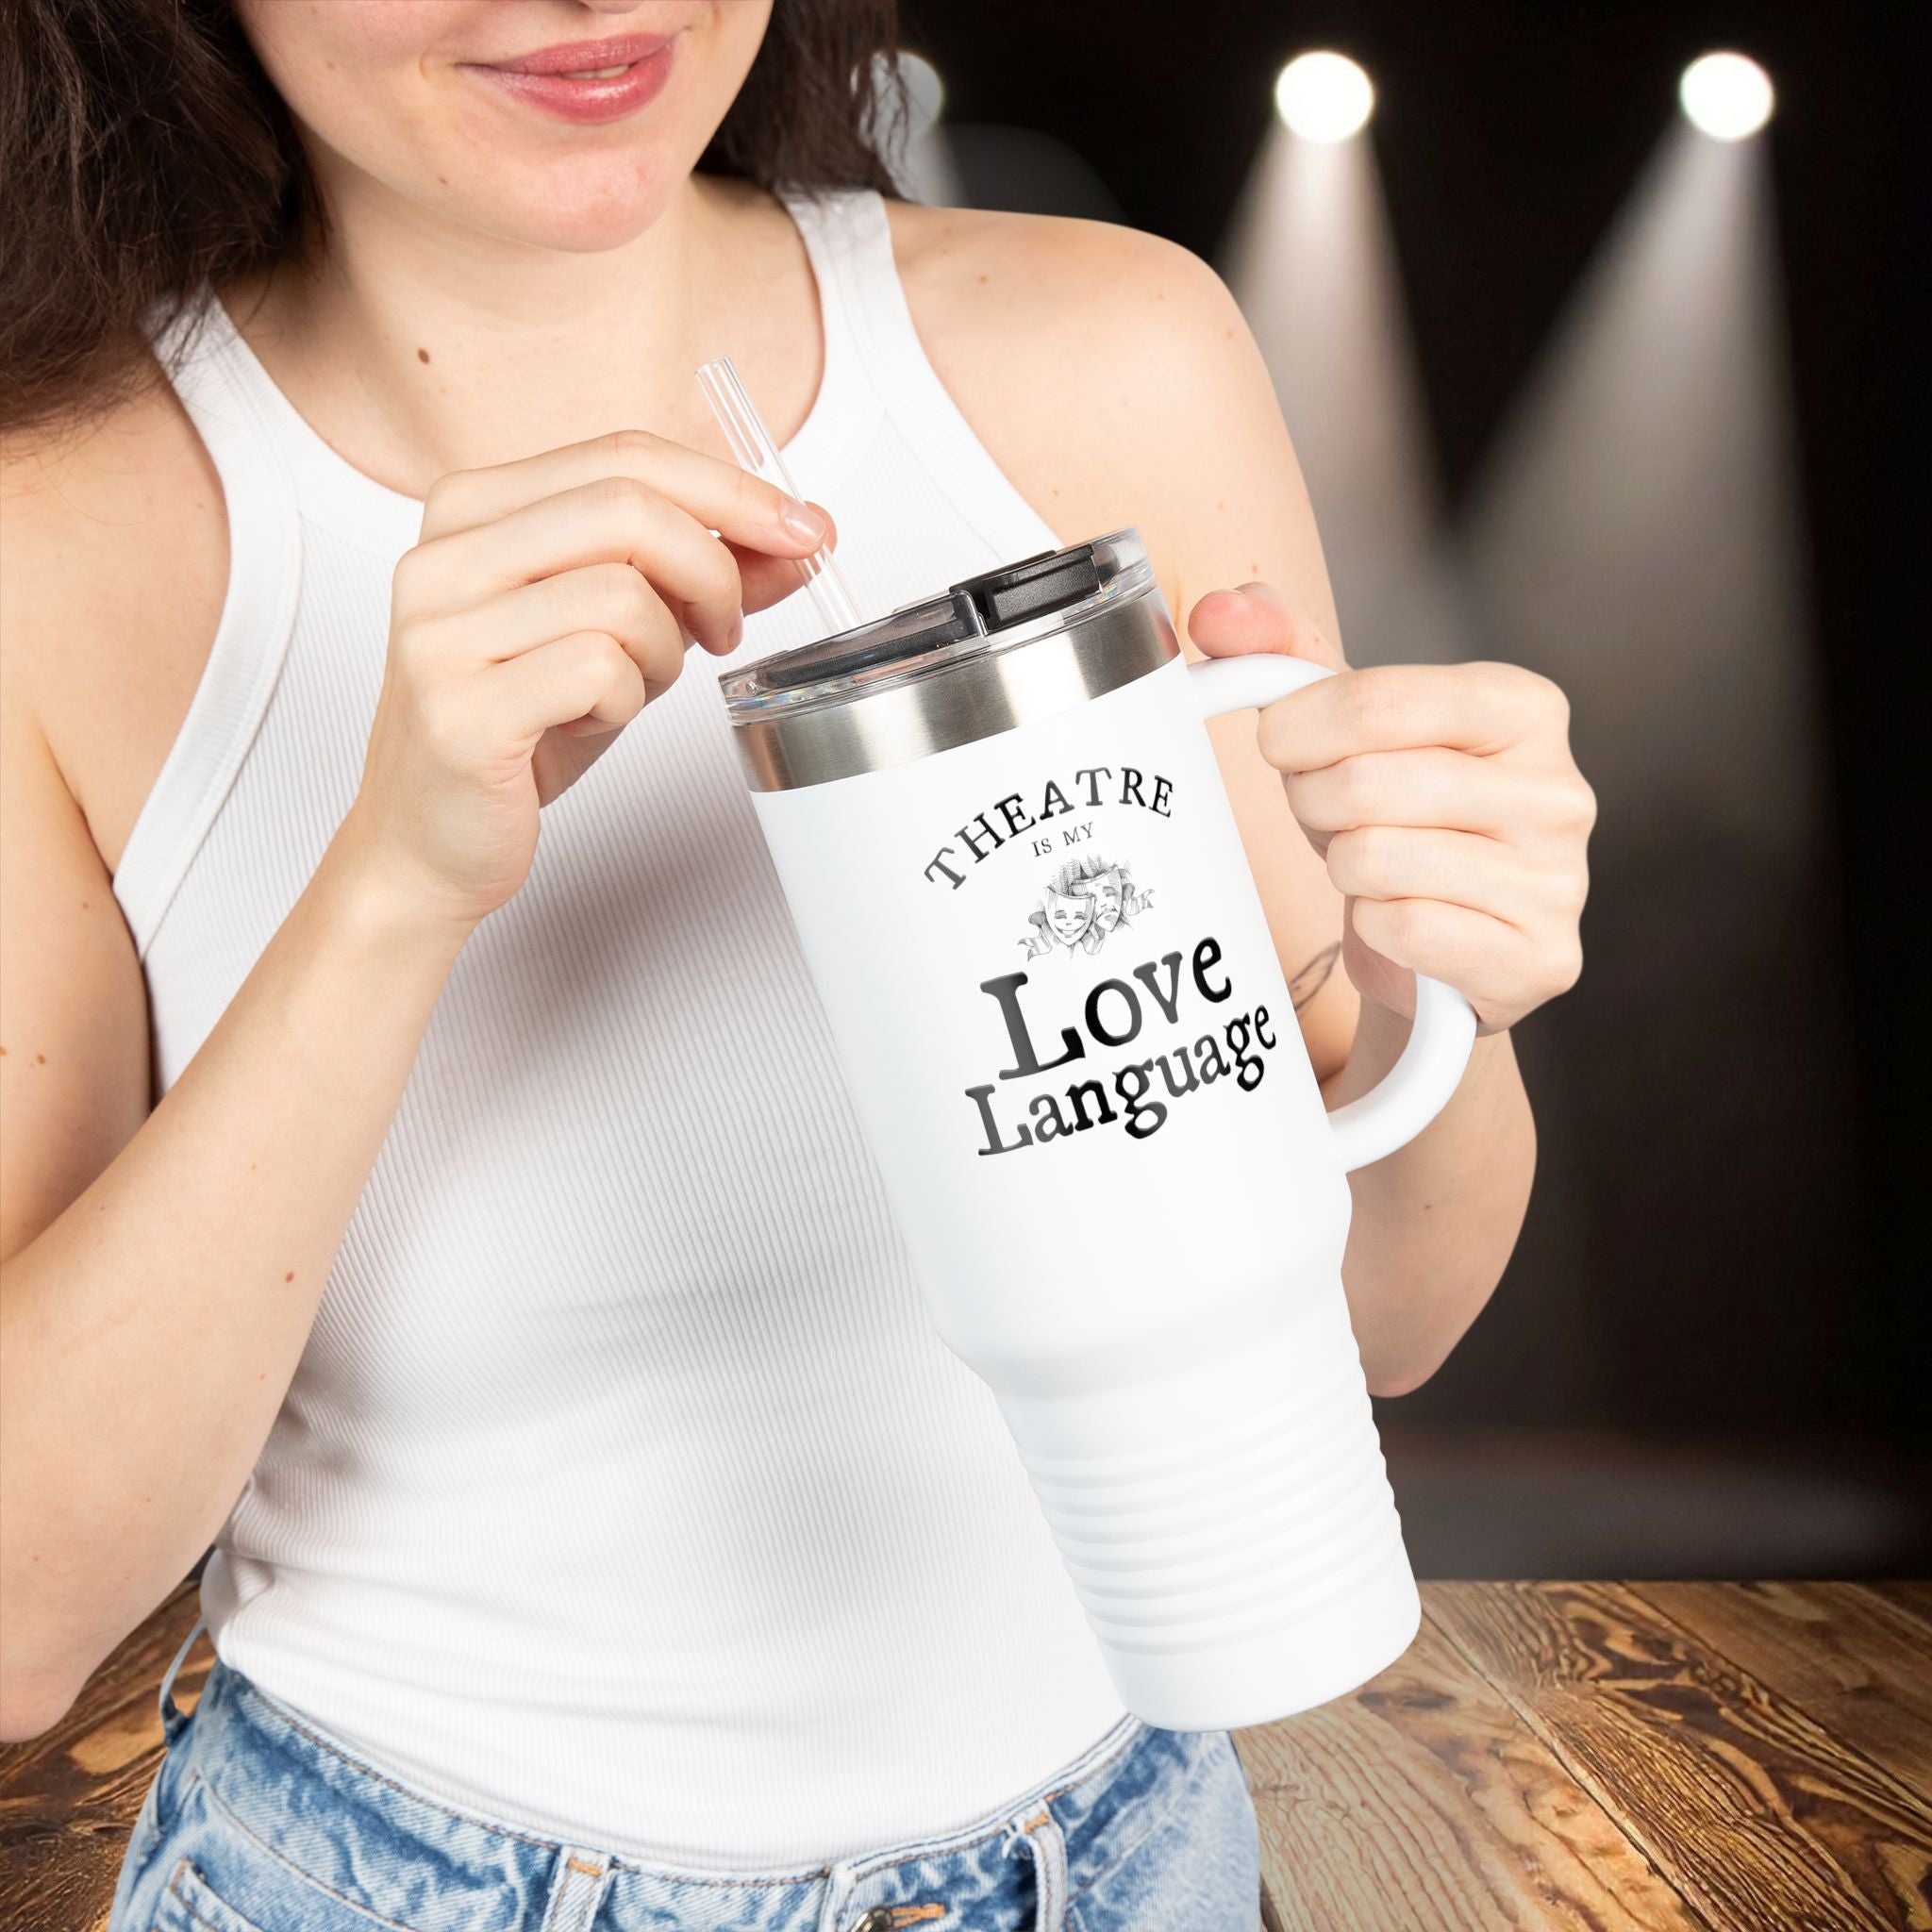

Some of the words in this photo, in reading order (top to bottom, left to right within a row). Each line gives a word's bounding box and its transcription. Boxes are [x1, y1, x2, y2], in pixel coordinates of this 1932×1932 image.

[924, 767, 1174, 891] THEATRE
[1031, 838, 1053, 858] IS
[1062, 822, 1094, 846] MY
[979, 936, 1232, 1080] Love
[964, 1005, 1277, 1157] Language
